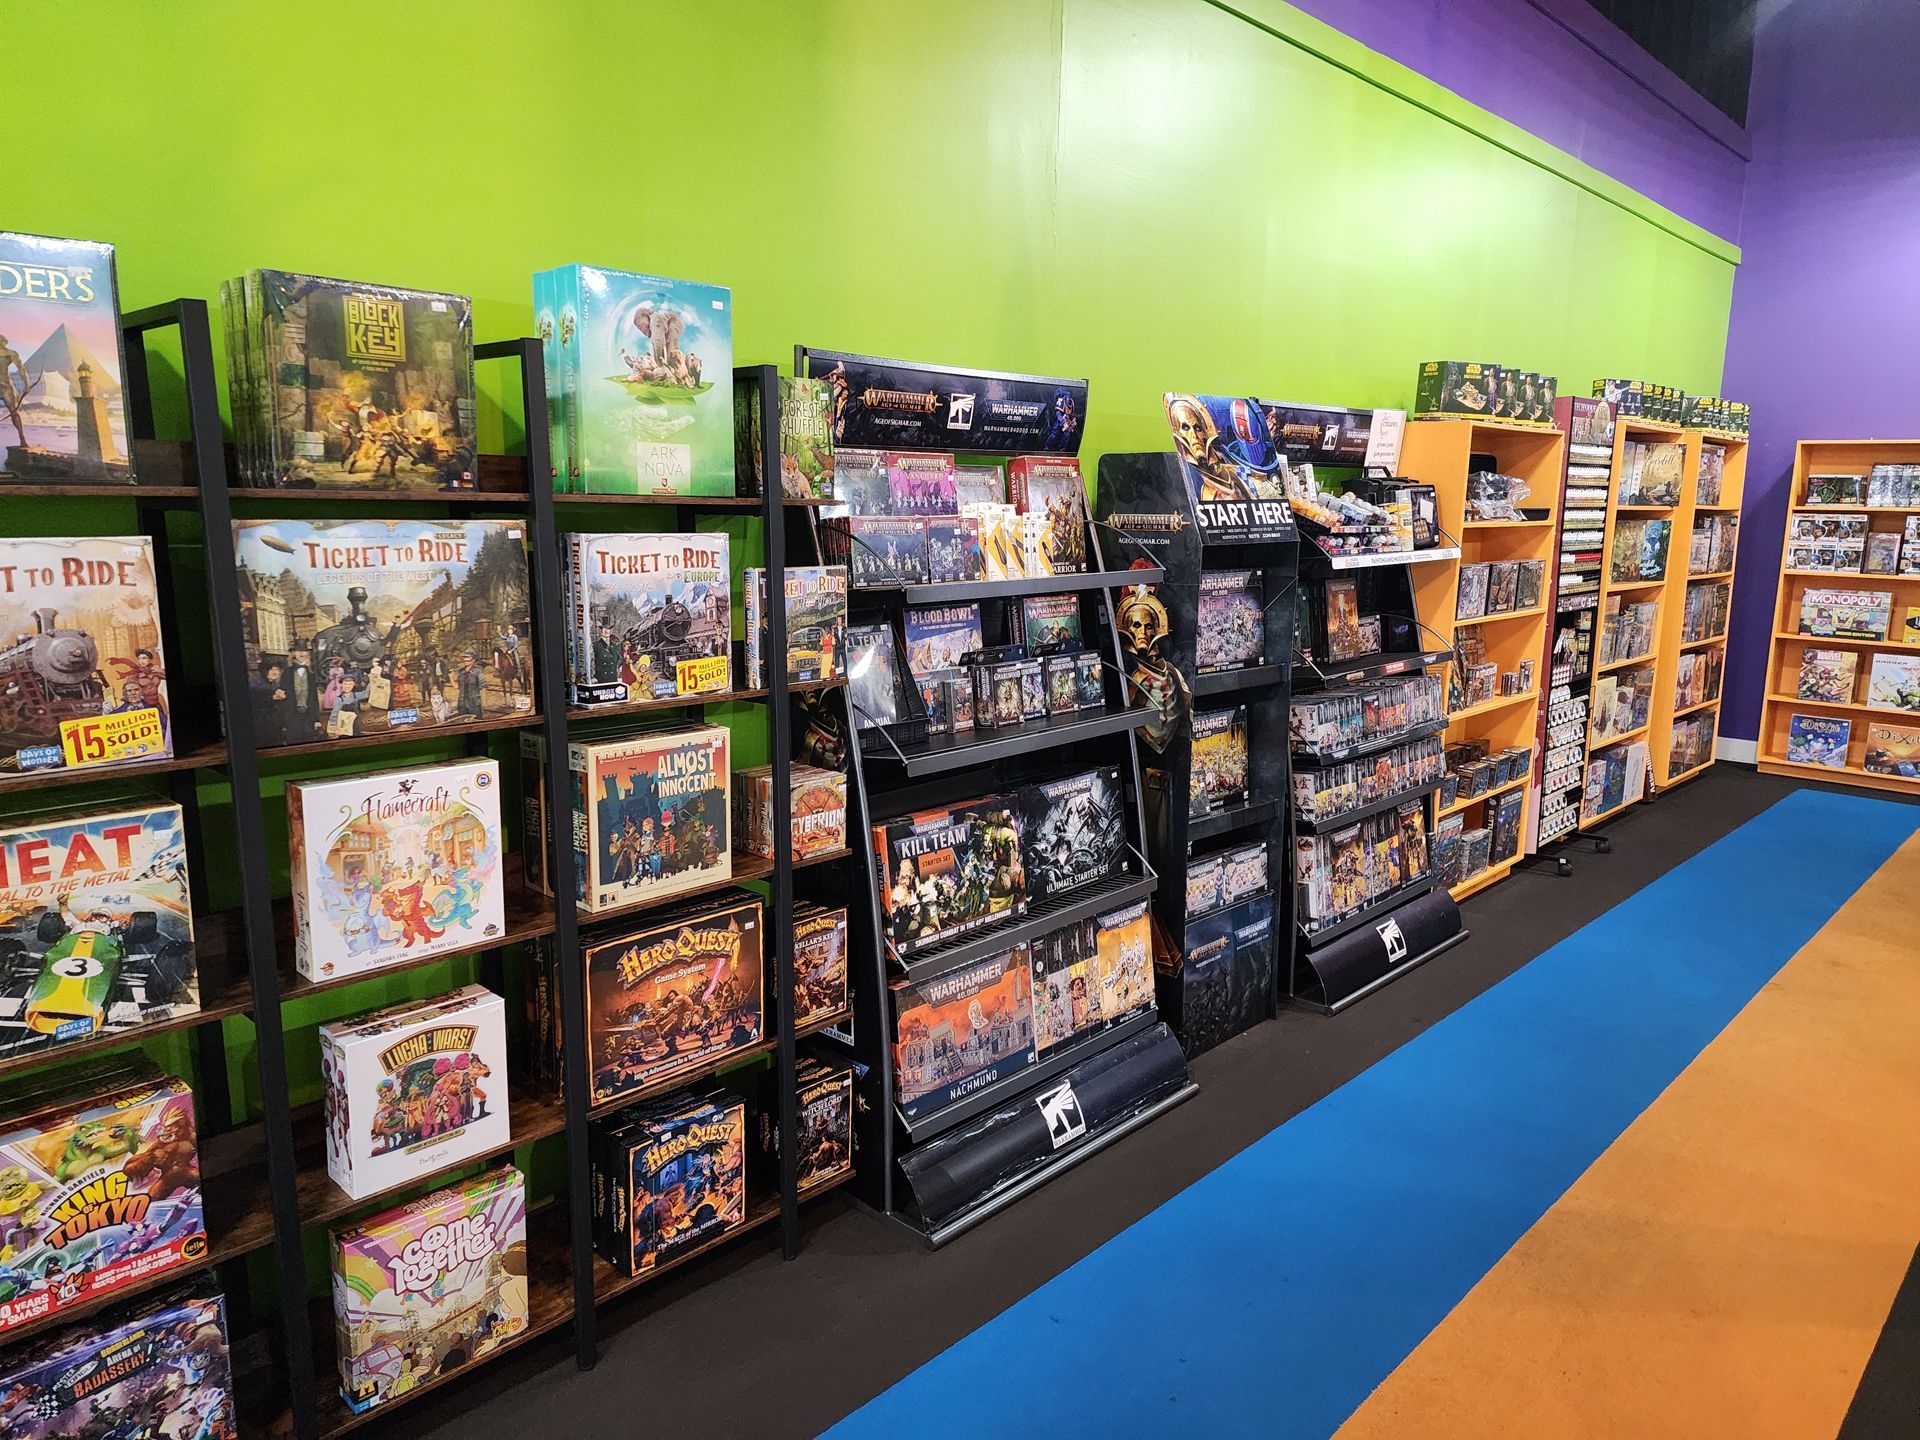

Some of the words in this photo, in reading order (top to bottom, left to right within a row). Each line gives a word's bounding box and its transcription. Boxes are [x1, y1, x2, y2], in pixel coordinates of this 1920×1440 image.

[348, 300, 399, 328] BLOCK
[350, 323, 400, 354] KEY
[784, 399, 820, 419] FOREST
[864, 389, 936, 413] WARHAMMER
[990, 403, 1039, 417] WARHAMMER
[781, 416, 823, 437] SHUFFLE
[874, 418, 922, 428] AGEOFSIGMAR.COM
[650, 446, 678, 461] ARK
[645, 461, 684, 478] NOVA
[906, 472, 945, 481] VANGUARD
[1010, 471, 1018, 508] WARRIO
[1107, 512, 1182, 533] WARHAMMER
[1196, 503, 1248, 527] START
[1250, 502, 1294, 525] HERE
[303, 541, 391, 569] TICKET
[393, 546, 413, 562] TO
[418, 538, 469, 564] RIDE
[595, 549, 661, 575] TICKET
[663, 554, 680, 569] TO
[683, 547, 720, 570] RIDE
[24, 568, 55, 588] TO
[62, 557, 137, 587] RIDE
[316, 572, 365, 585] LEGENDS
[367, 571, 383, 583] OF
[384, 570, 405, 582] THE
[406, 569, 435, 582] WEST
[683, 570, 720, 584] EUROPE
[1200, 576, 1244, 590] ARHAMMER
[817, 575, 845, 594] RIDE
[1811, 594, 1882, 607] MONOPOLY
[911, 609, 942, 624] BLOOD
[944, 607, 974, 621] BOWL
[1027, 603, 1078, 620] WARHAMMER
[859, 634, 884, 647] TEAM
[678, 665, 699, 692] 15
[698, 659, 726, 670] MILLION
[699, 668, 727, 683] SOLD!
[592, 687, 615, 697] UNBOX
[599, 692, 616, 701] NOW
[66, 724, 106, 764] 15
[105, 711, 157, 731] MILLION
[107, 725, 159, 747] SOLD!
[20, 748, 44, 758] DAYS
[45, 748, 57, 756] OF
[22, 755, 60, 767] WONDER
[658, 748, 716, 779] ALMOST
[658, 772, 716, 798] INNOCENT
[1047, 778, 1092, 798] WARHAMMER
[360, 786, 451, 825] Flamecraft
[572, 808, 581, 853] INNOCENT
[579, 812, 588, 855] ALMOST
[916, 819, 949, 834] WARHAMMER
[901, 837, 930, 859] KILL
[931, 827, 966, 850] TEAM
[922, 858, 942, 868] STARTER
[25, 885, 43, 899] TO
[50, 878, 79, 895] THE
[83, 868, 130, 888] METAL
[1047, 875, 1074, 894] ULTIMATE
[1075, 867, 1098, 884] STARTER
[1099, 863, 1109, 876] SET
[1103, 908, 1144, 929] WARHAMMER
[940, 926, 959, 939] COMBAT
[960, 924, 965, 932] IN
[966, 920, 975, 930] THE
[64, 958, 87, 977] 3
[655, 971, 677, 985] Game
[678, 963, 706, 977] System
[930, 963, 1002, 1002] WARHAMMER
[956, 986, 979, 1000] 40,000
[57, 1022, 78, 1034] DAYS
[79, 1019, 91, 1028] OF
[386, 1036, 428, 1067] LUCHA
[433, 1027, 472, 1050] WARS!
[634, 1069, 649, 1081] High
[649, 1060, 678, 1076] Adventure
[678, 1057, 684, 1065] in
[688, 1050, 705, 1061] World
[710, 1042, 727, 1053] Magic
[950, 1069, 997, 1100] NACHMUND
[801, 1105, 825, 1118] WITCH
[825, 1096, 842, 1108] LORD
[41, 1190, 67, 1216] RICHARD
[68, 1167, 106, 1192] GARFIELD
[49, 1170, 129, 1224] KING
[44, 1193, 152, 1250] TOKYO
[137, 1248, 172, 1267] MILLION
[58, 1285, 76, 1299] 10
[14, 1294, 49, 1314] YEARS
[106, 1348, 133, 1367] ARENA
[52, 1368, 76, 1391] MISTER
